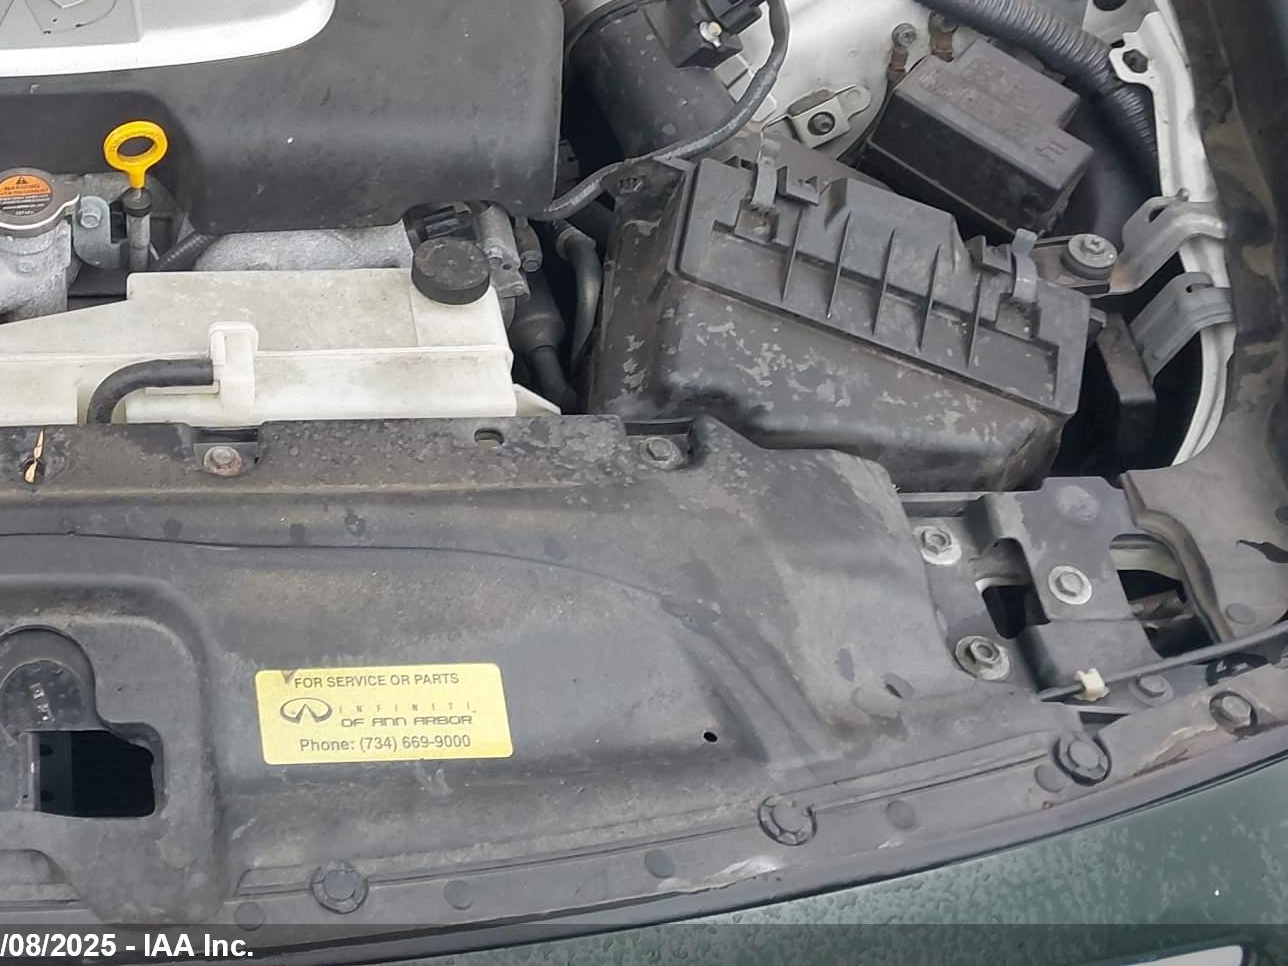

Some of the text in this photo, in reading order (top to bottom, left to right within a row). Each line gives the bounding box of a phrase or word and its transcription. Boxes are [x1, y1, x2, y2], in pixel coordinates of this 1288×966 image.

[295, 673, 460, 689] FOR SERVICE OR PARTS
[341, 718, 365, 728] OF
[413, 715, 473, 727] ARBOR
[300, 734, 471, 753] Phone: (734) 669-9000
